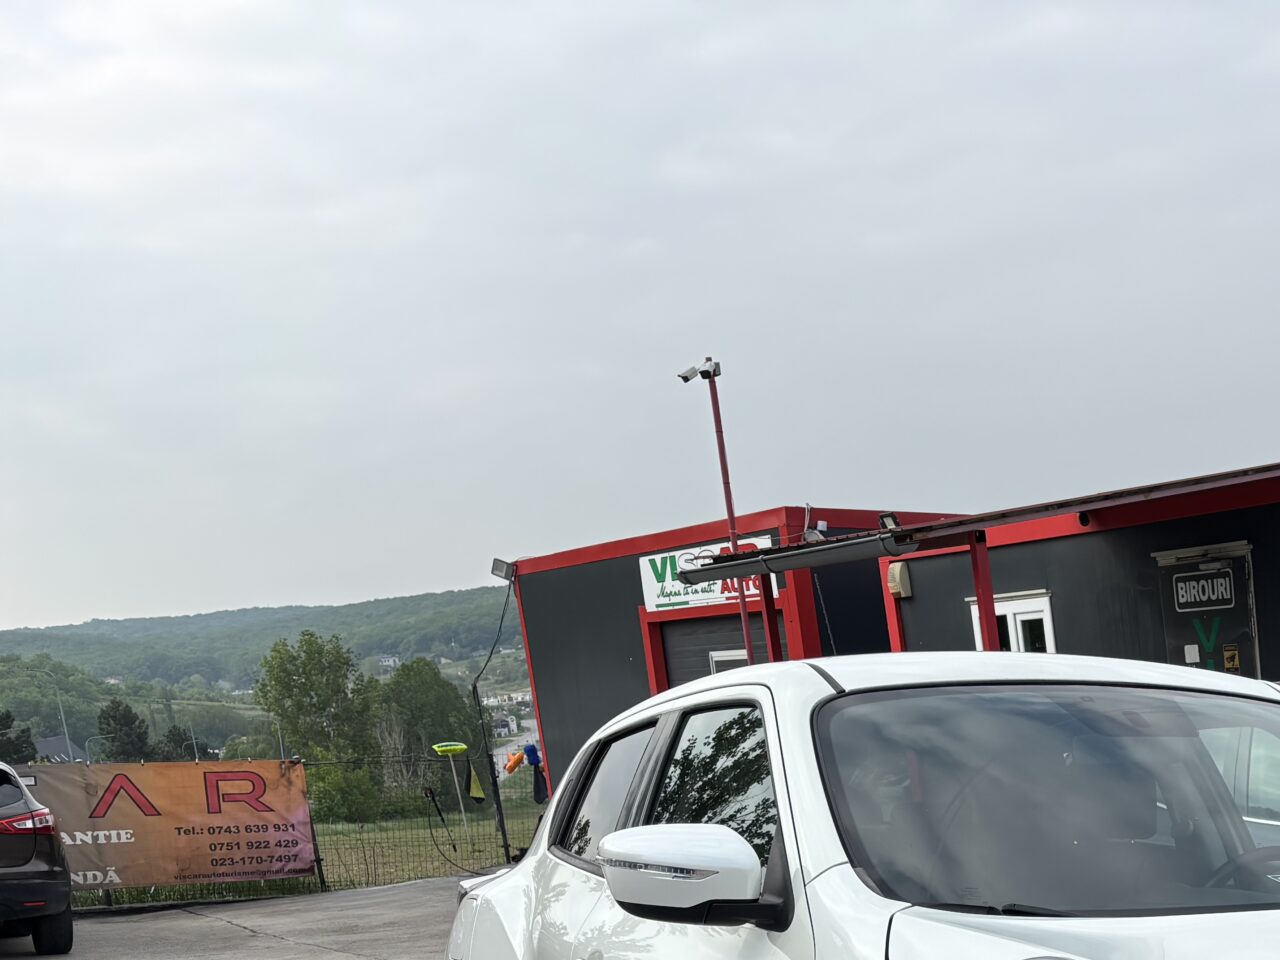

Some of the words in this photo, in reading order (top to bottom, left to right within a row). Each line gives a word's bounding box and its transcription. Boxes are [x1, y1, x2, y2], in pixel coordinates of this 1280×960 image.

[1177, 577, 1230, 603] BIROURI
[174, 826, 204, 836] Tel.:
[207, 825, 241, 836] 0743
[245, 824, 269, 834] 639
[273, 823, 296, 833] 931
[209, 841, 241, 852] 0751
[246, 840, 271, 850] 922
[275, 839, 299, 849] 429
[210, 854, 299, 867] 023-170-7497
